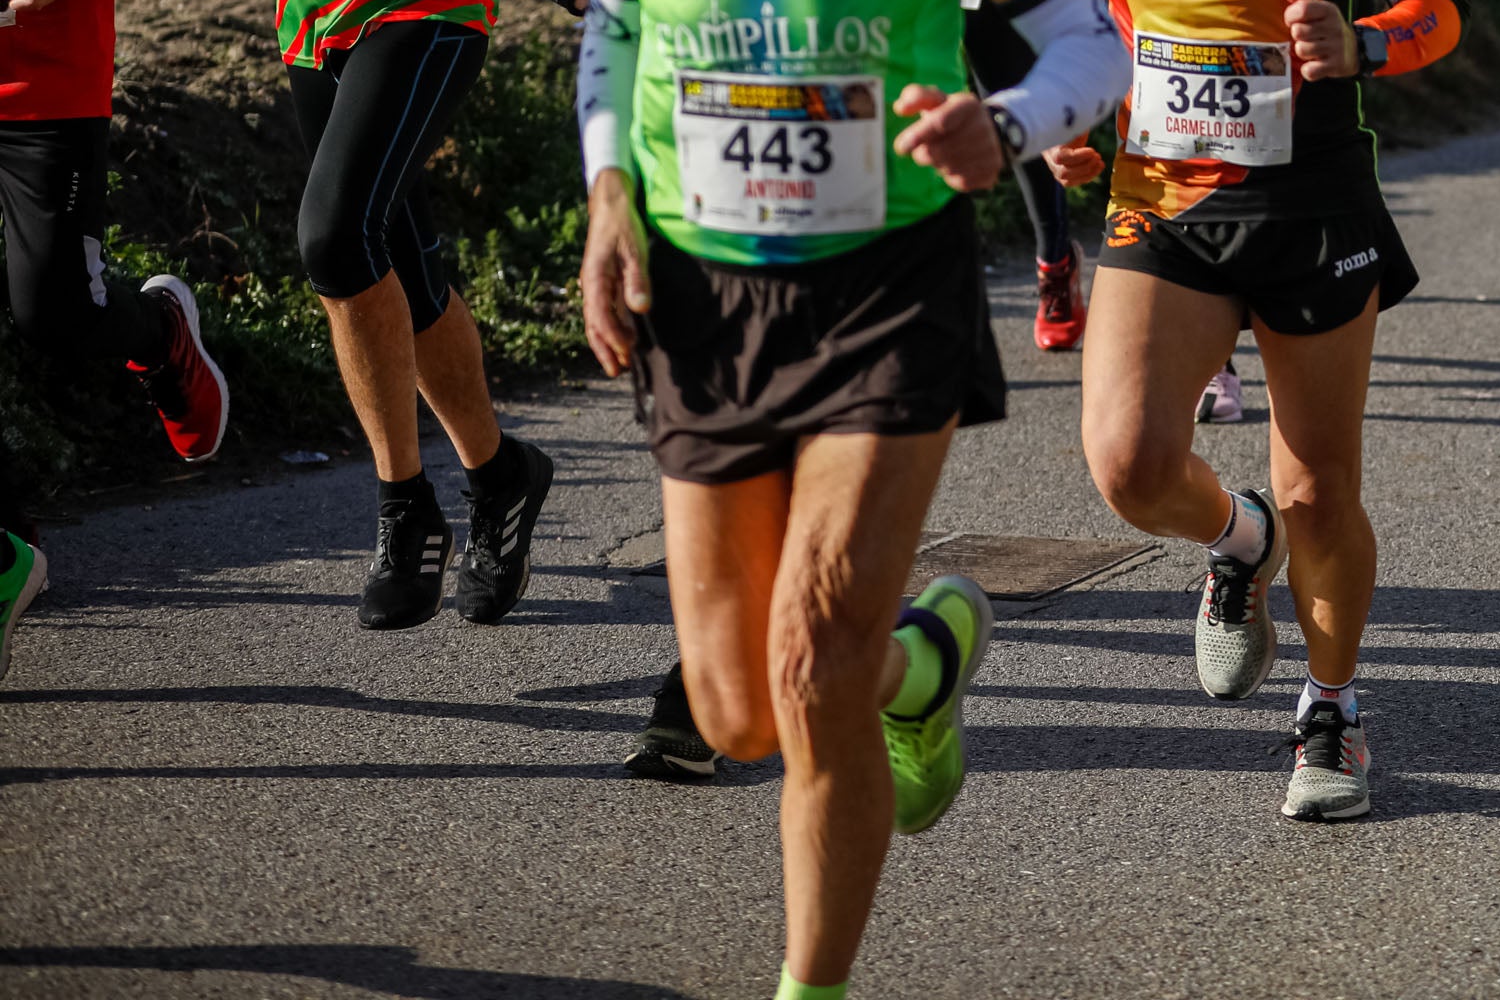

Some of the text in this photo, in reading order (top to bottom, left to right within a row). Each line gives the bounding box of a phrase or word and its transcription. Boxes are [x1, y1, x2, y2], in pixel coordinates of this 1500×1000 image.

[656, 3, 892, 62] CAMPILLOS
[1140, 38, 1153, 51] 26
[1172, 44, 1229, 57] CARRERA
[1172, 53, 1228, 64] POPULAR
[1167, 74, 1250, 118] 343
[1166, 116, 1256, 138] CARMELO GCIA
[722, 125, 833, 174] 443
[745, 179, 816, 199] ANTONIO
